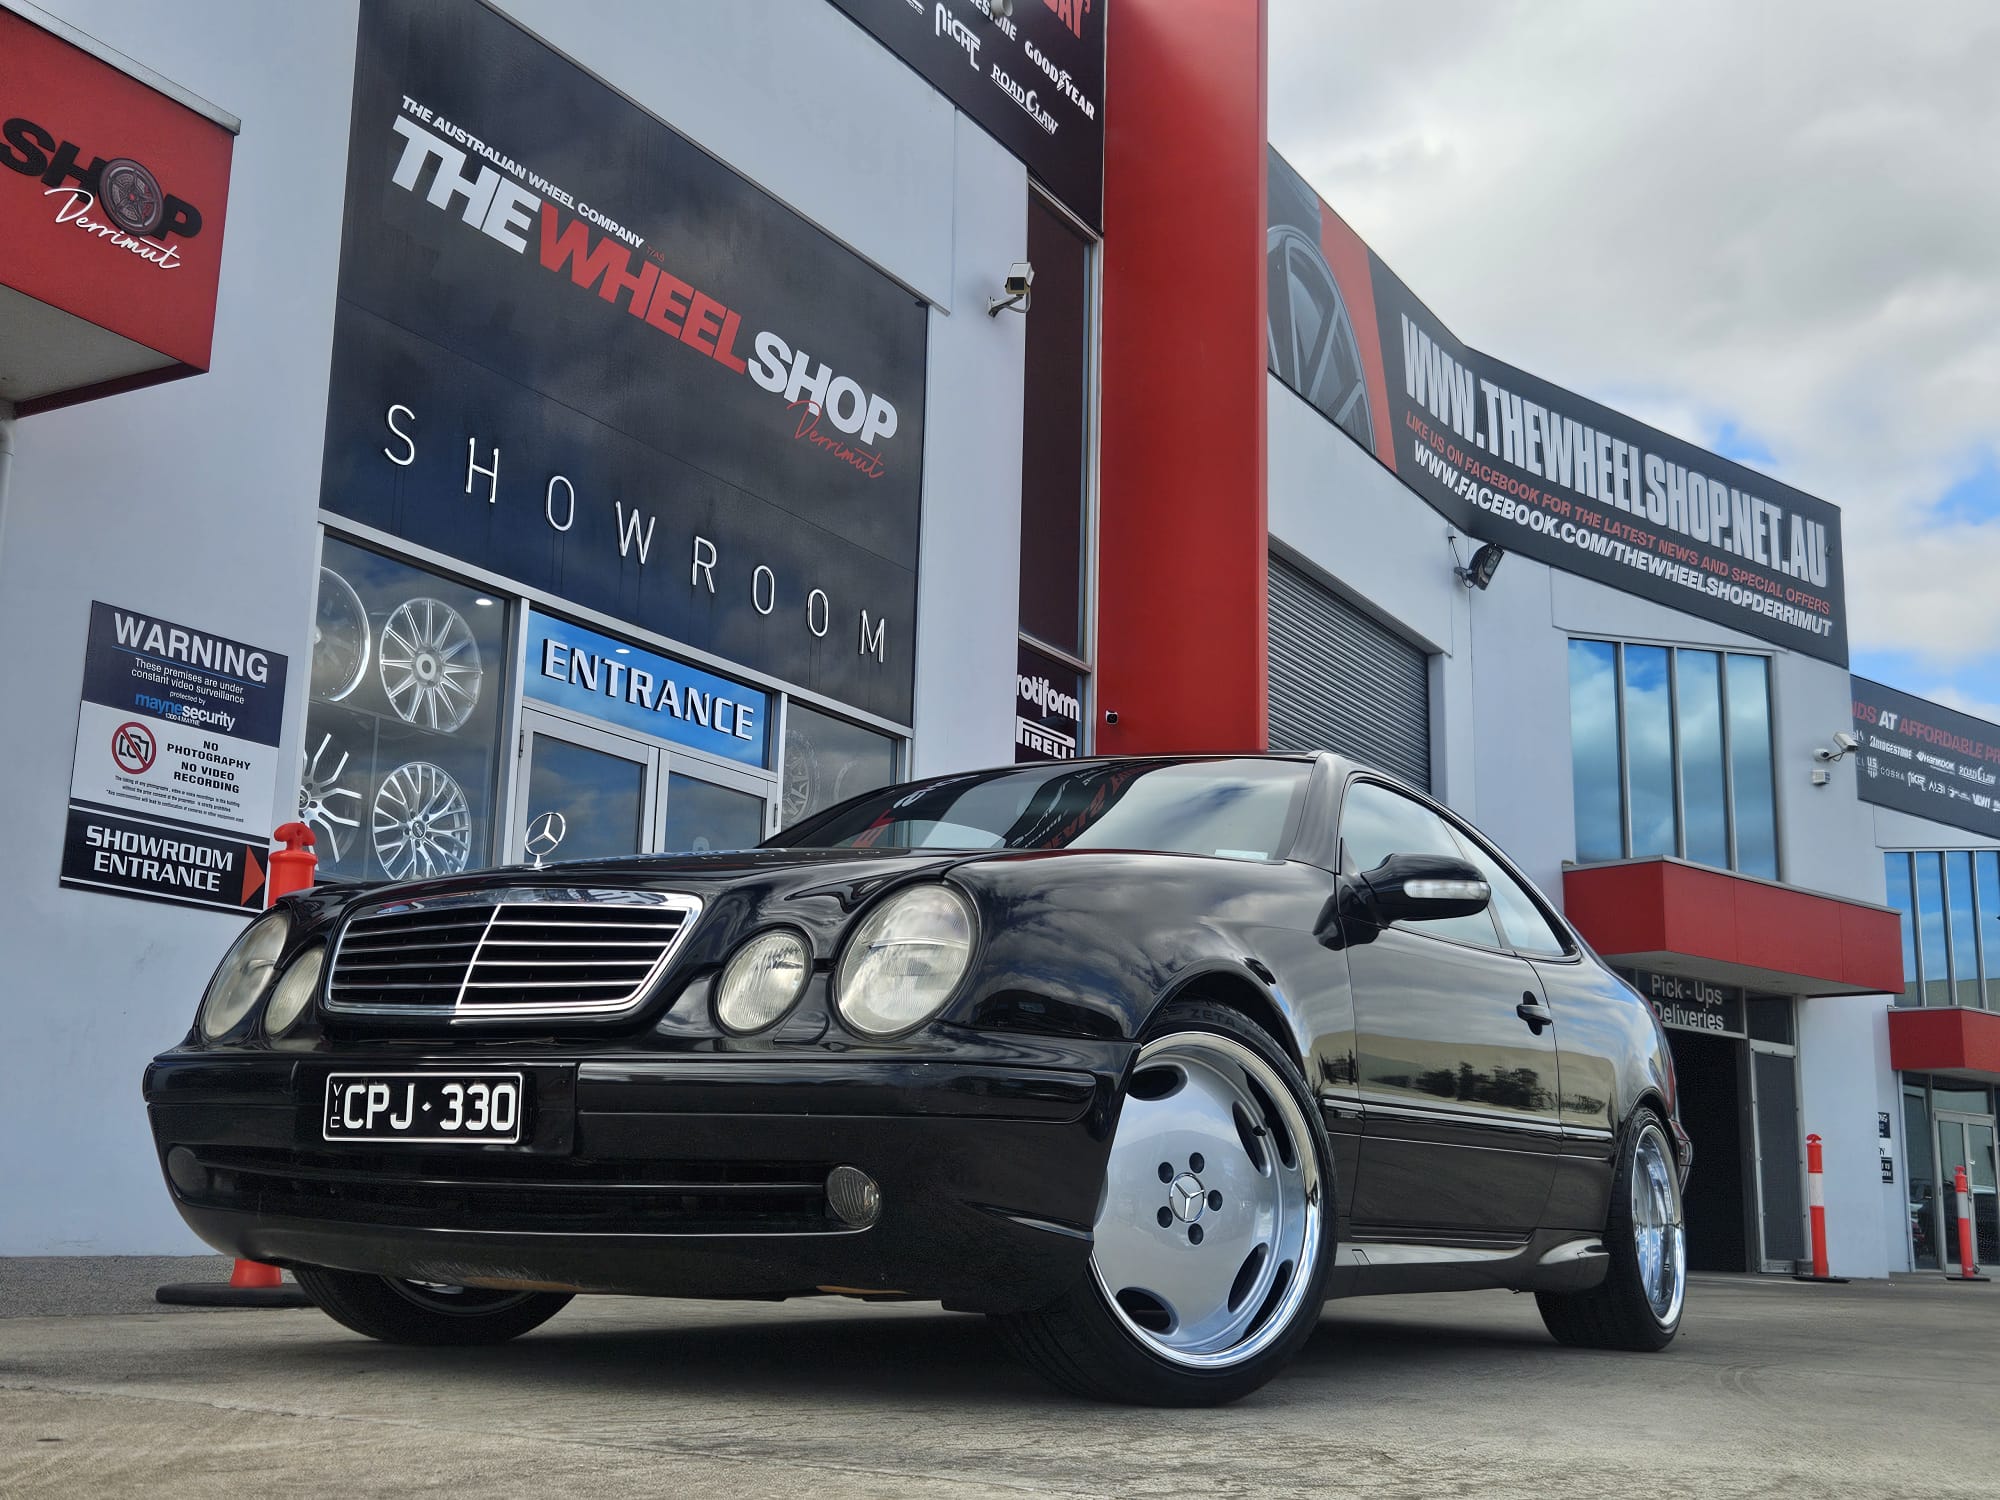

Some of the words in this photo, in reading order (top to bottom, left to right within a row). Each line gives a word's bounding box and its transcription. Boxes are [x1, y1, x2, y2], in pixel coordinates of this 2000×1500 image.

[1025, 41, 1095, 120] GOODYEAR
[402, 95, 432, 123] THE
[432, 116, 527, 180] AUSTRALIAN
[529, 171, 575, 210] WHEEL
[577, 202, 645, 249] COMPANY
[44, 188, 181, 269] Derrimut
[787, 400, 885, 478] Derrimut
[1401, 313, 1828, 588] WWW.THEWHEELSHOP.NET.AU
[1406, 411, 1428, 441] LIKE
[1430, 430, 1445, 454] US
[1447, 444, 1463, 467] ON
[1465, 457, 1541, 505] FACEBOOK
[1542, 493, 1571, 517] FOR
[1575, 506, 1601, 528] THE
[1604, 517, 1656, 549] LATEST
[1658, 539, 1698, 565] NEWS
[1701, 556, 1729, 577] AND
[1731, 567, 1784, 598] SPECIAL
[1785, 588, 1830, 616] OFFERS
[1414, 440, 1832, 637] WWW.FACEBOOK.COM/THEWHEELSHOPDERRIMUT
[114, 612, 268, 684] WARNING
[131, 669, 169, 685] constant
[171, 679, 193, 691] video
[196, 685, 245, 705] surveillance
[135, 657, 161, 672] These
[164, 665, 202, 684] premises
[204, 678, 217, 688] are
[219, 681, 243, 694] under
[541, 638, 756, 740] ENTRANCE
[167, 743, 251, 770] PHOTOGRAPHY
[203, 740, 218, 752] NO
[1879, 710, 1898, 730] AT
[1899, 717, 1984, 759] AFFORDABLE
[173, 771, 239, 794] RECORDING
[181, 761, 197, 773] NO
[201, 765, 235, 781] VIDEO
[85, 825, 233, 872] SHOWROOM
[93, 850, 221, 892] ENTRANCE
[1190, 1008, 1236, 1028] ZETA
[1652, 1001, 1724, 1030] Deliveries
